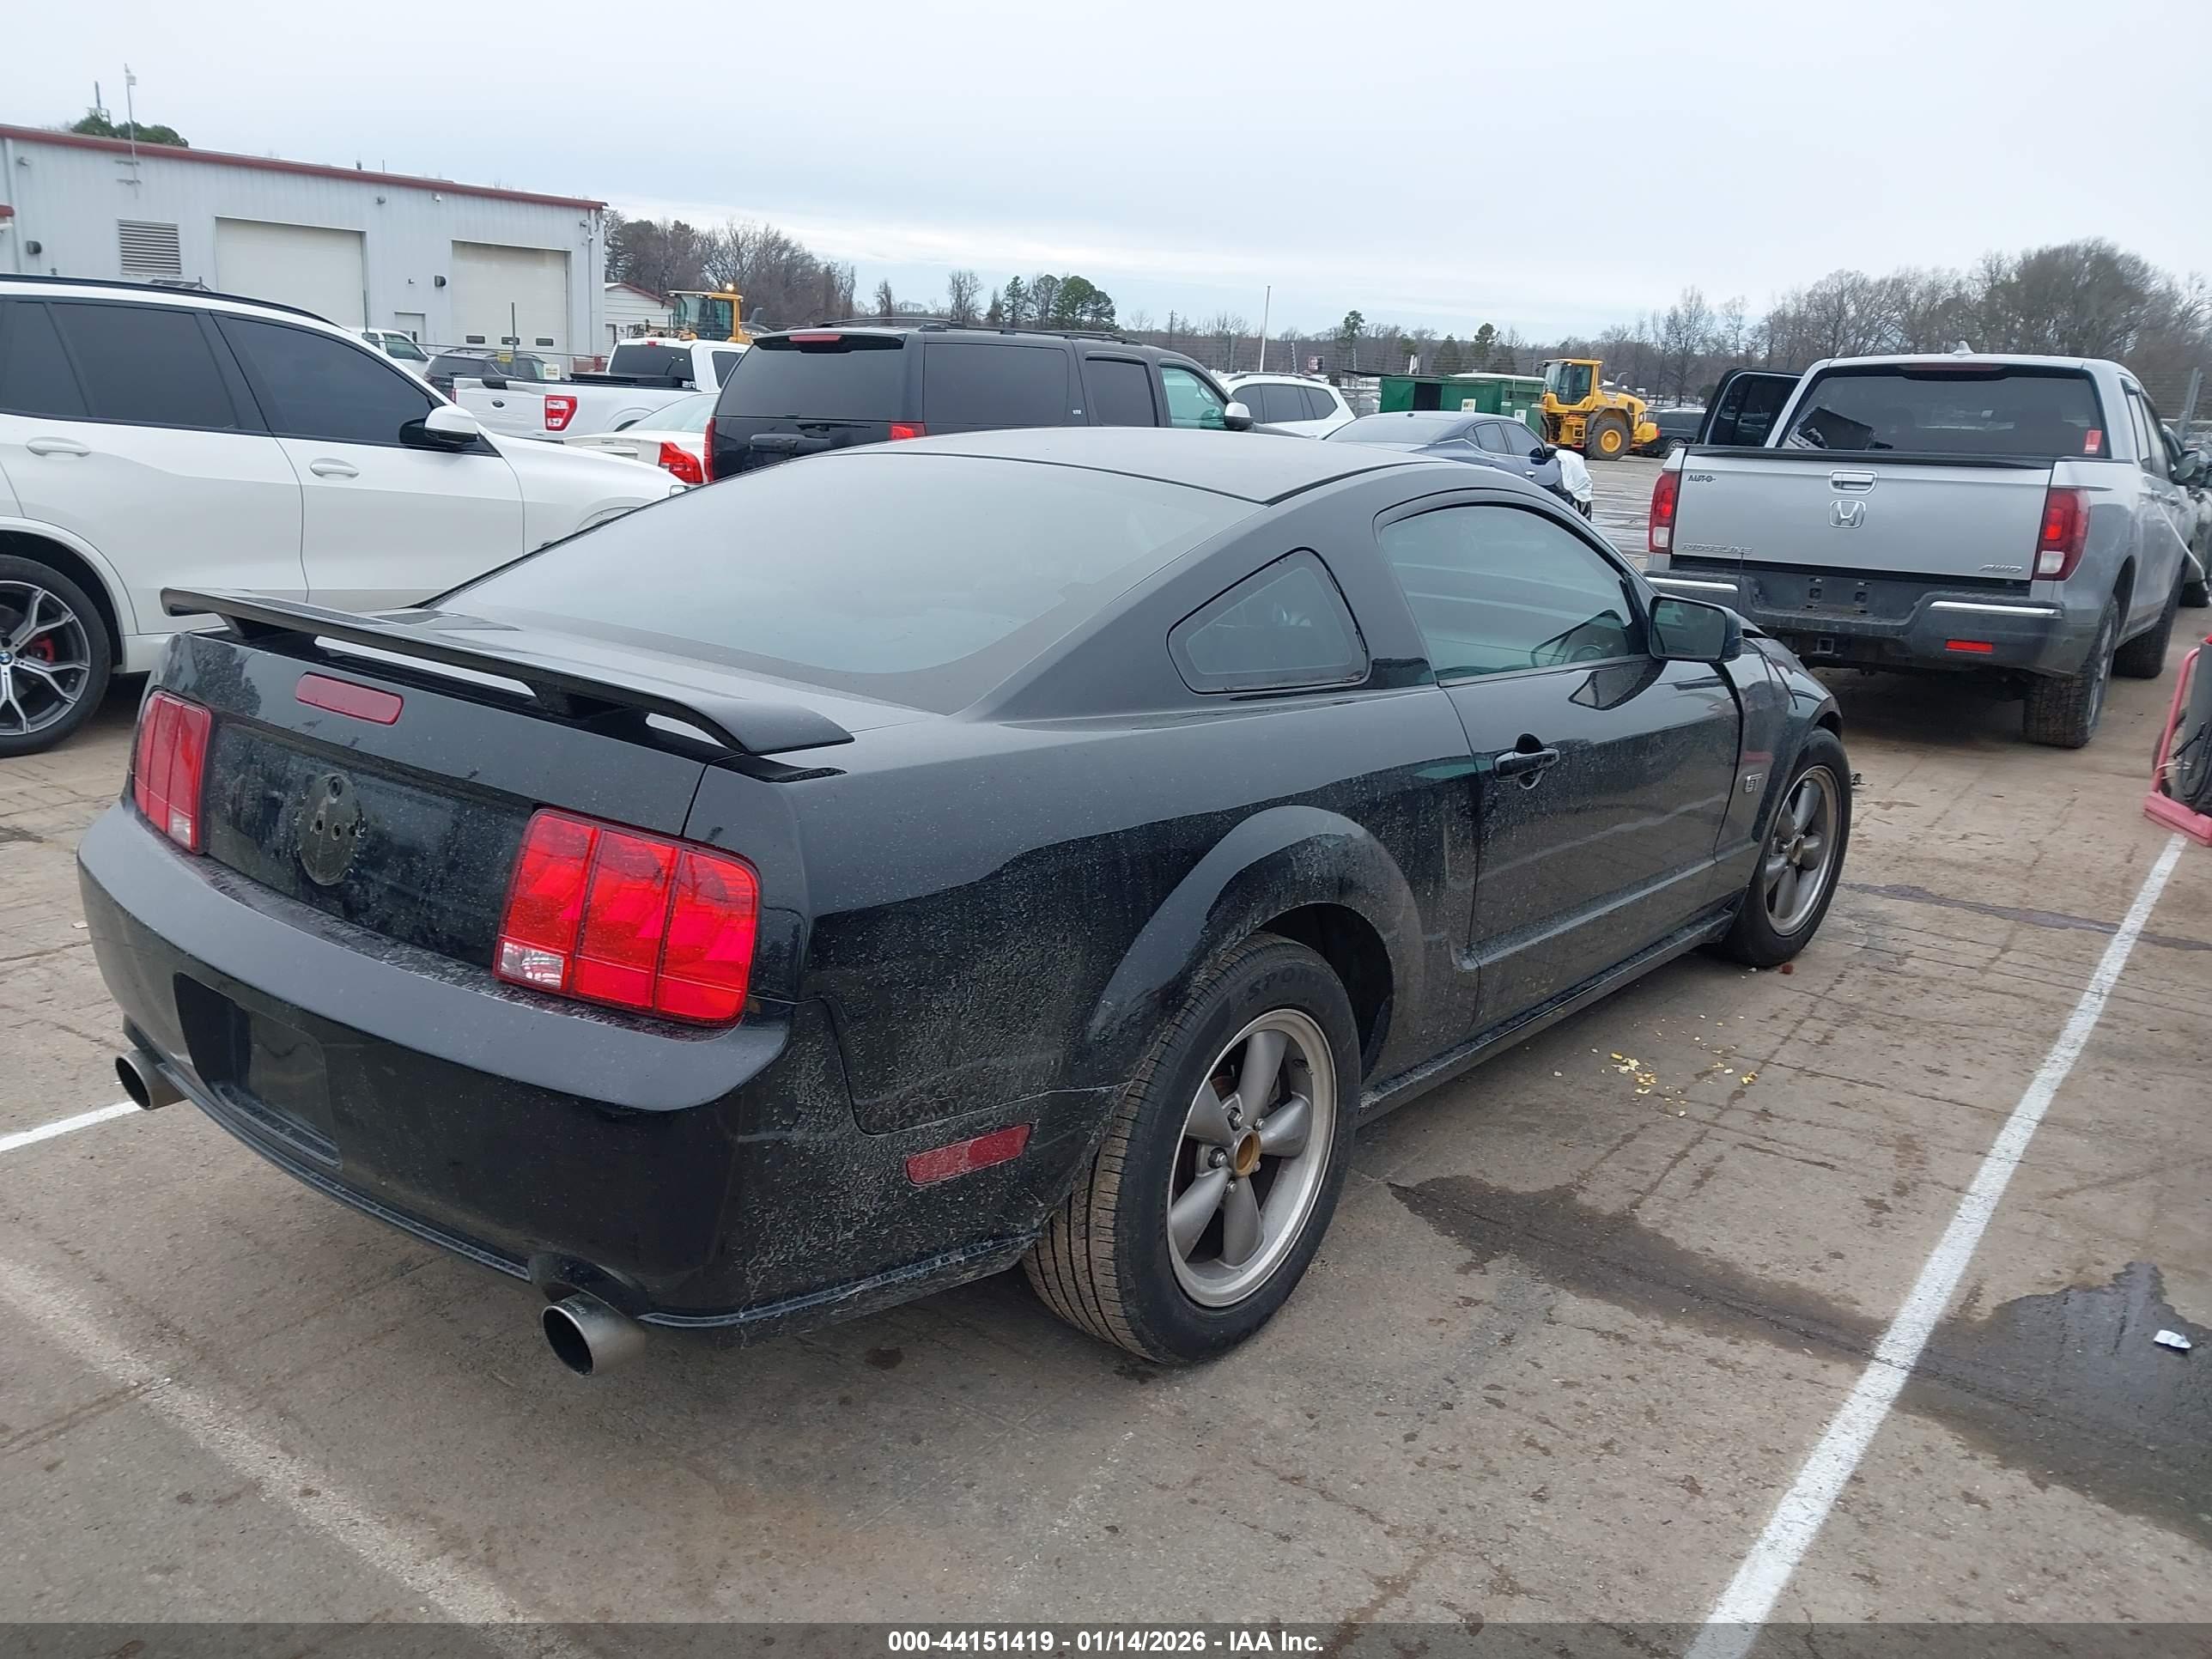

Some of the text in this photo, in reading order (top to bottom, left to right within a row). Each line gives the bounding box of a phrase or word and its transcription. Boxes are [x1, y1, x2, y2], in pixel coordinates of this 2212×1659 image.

[1682, 543, 1752, 556] RIDGELINE
[1978, 563, 2023, 574] AWD
[1744, 772, 1764, 793] GT
